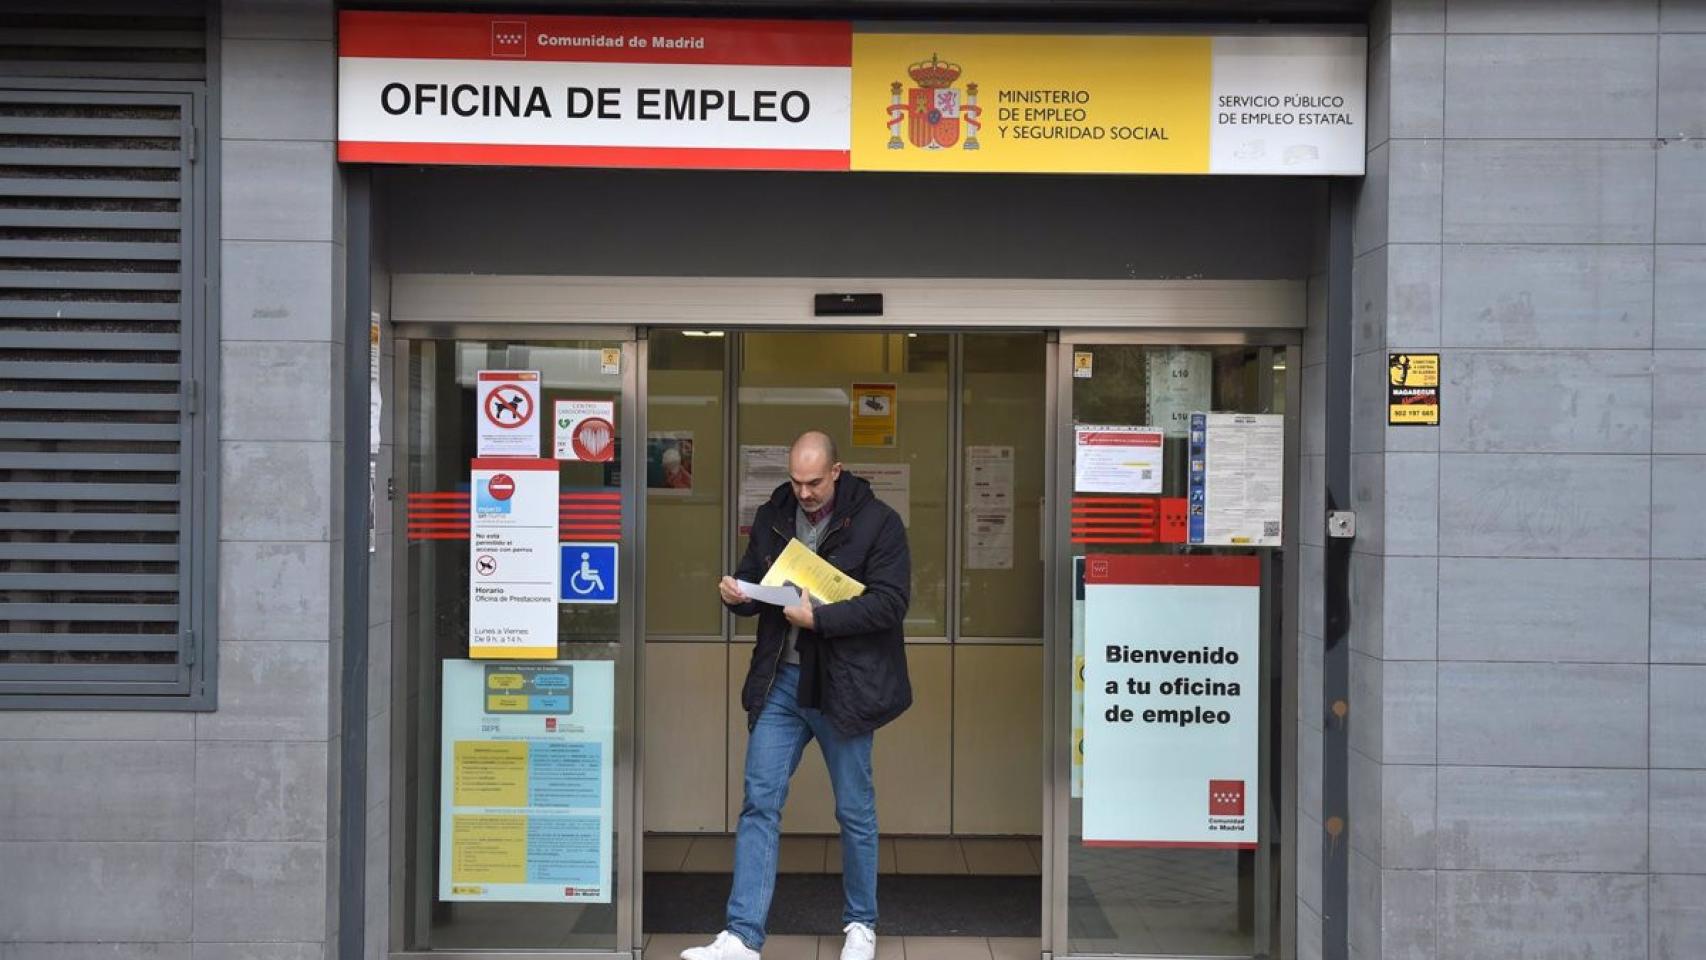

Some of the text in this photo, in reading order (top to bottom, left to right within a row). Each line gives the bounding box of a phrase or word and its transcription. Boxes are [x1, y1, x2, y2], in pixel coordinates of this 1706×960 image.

[537, 33, 705, 50] Comunidad de Madrid
[380, 82, 811, 123] OFICINA DE EMPLEO
[998, 89, 1090, 105] MINISTERIO
[1218, 92, 1345, 110] SERVICIO PÚBLICO
[998, 107, 1087, 123] DE EMPLEO
[1218, 111, 1354, 127] DE EMPLEO ESTATAL
[998, 125, 1169, 142] Y SEGURIDAD SOCIAL
[1105, 645, 1239, 665] Bienvenido
[1104, 677, 1241, 697] a tu oficina
[1104, 705, 1231, 727] de empleo
